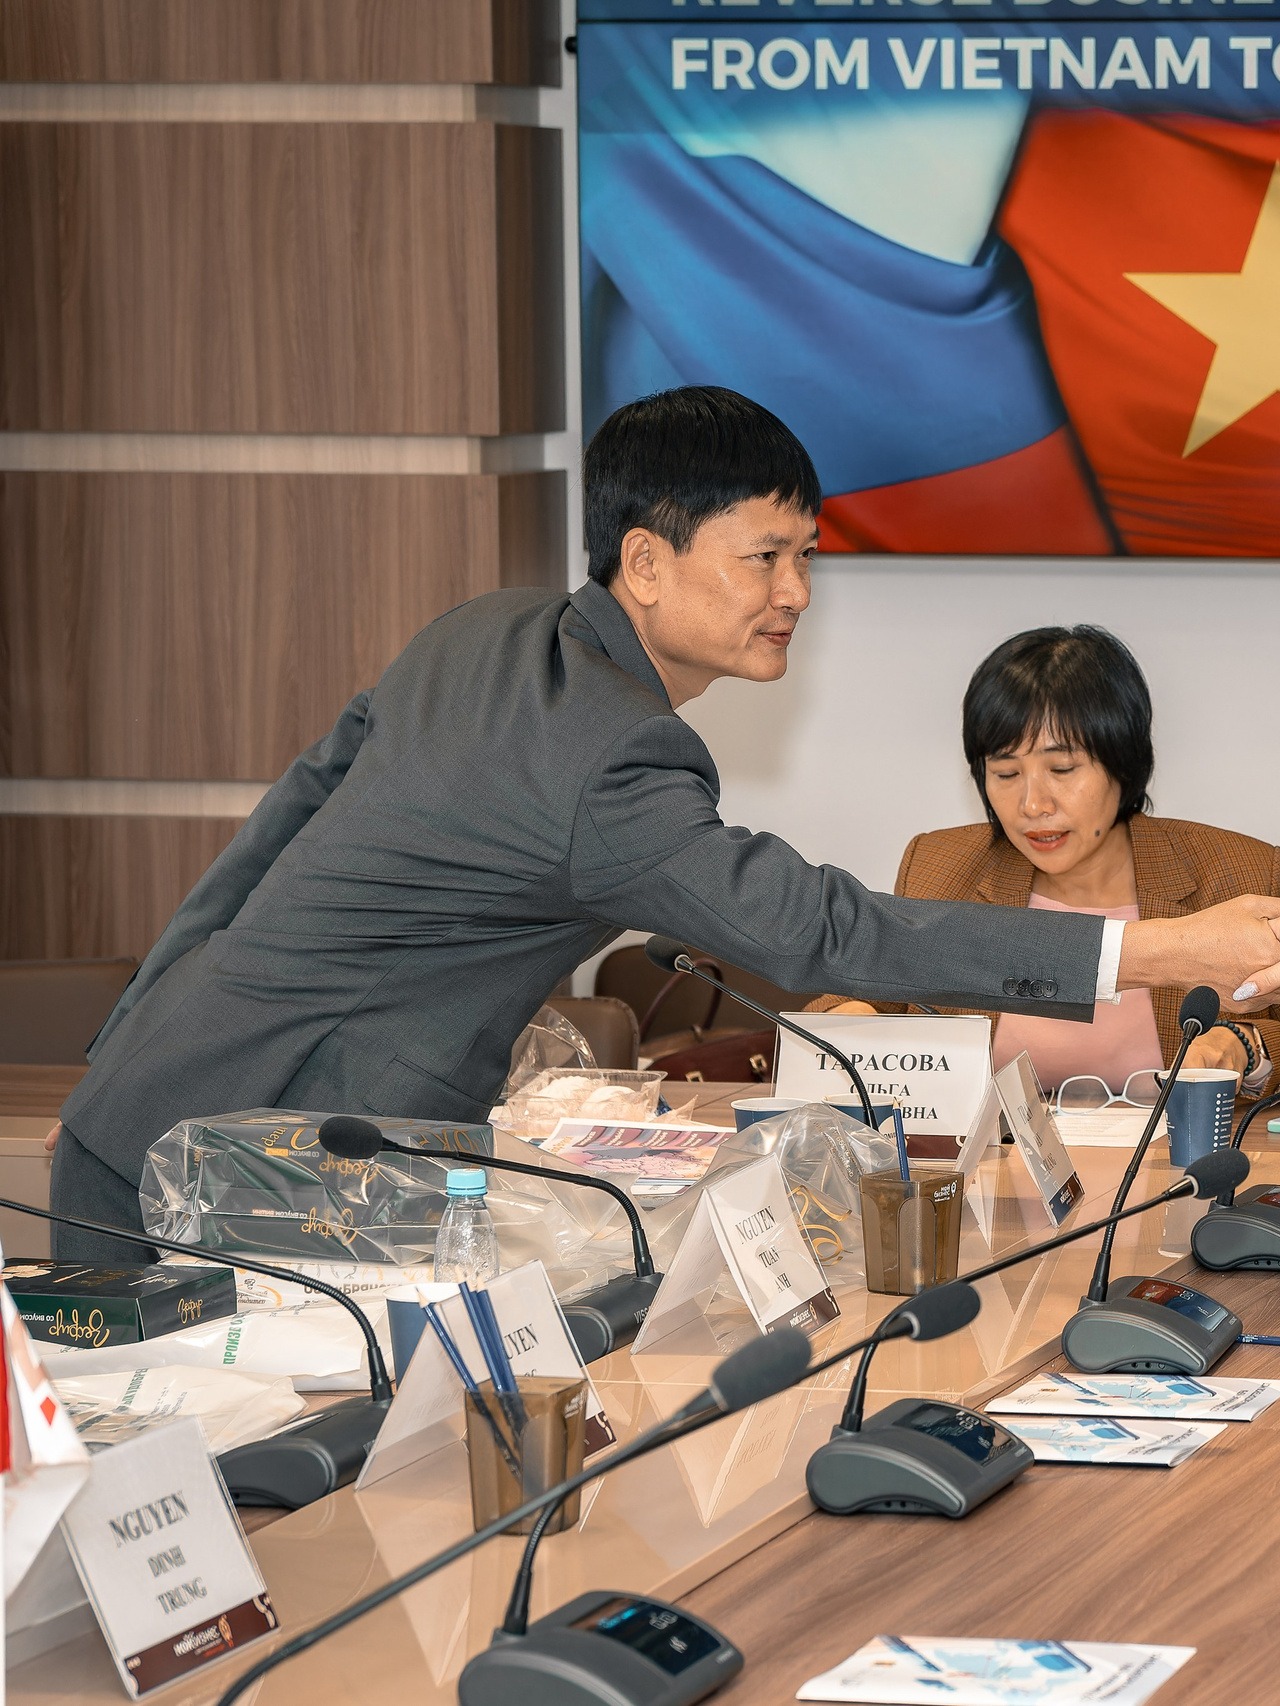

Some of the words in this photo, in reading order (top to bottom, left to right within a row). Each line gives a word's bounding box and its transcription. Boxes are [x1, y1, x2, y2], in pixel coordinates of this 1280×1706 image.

[671, 37, 869, 91] FROM
[887, 36, 1211, 91] VIETNAM
[815, 1053, 951, 1072] ТАРАСОВА
[735, 1206, 777, 1245] NGUYEN
[759, 1244, 781, 1268] TUAN
[775, 1272, 792, 1294] ANH
[48, 1308, 111, 1348] Зефир
[633, 1305, 650, 1324] VISS
[503, 1323, 540, 1361] UYEN
[109, 1490, 191, 1548] NGUYEN
[148, 1545, 187, 1578] DINH
[156, 1577, 208, 1615] TRUNG
